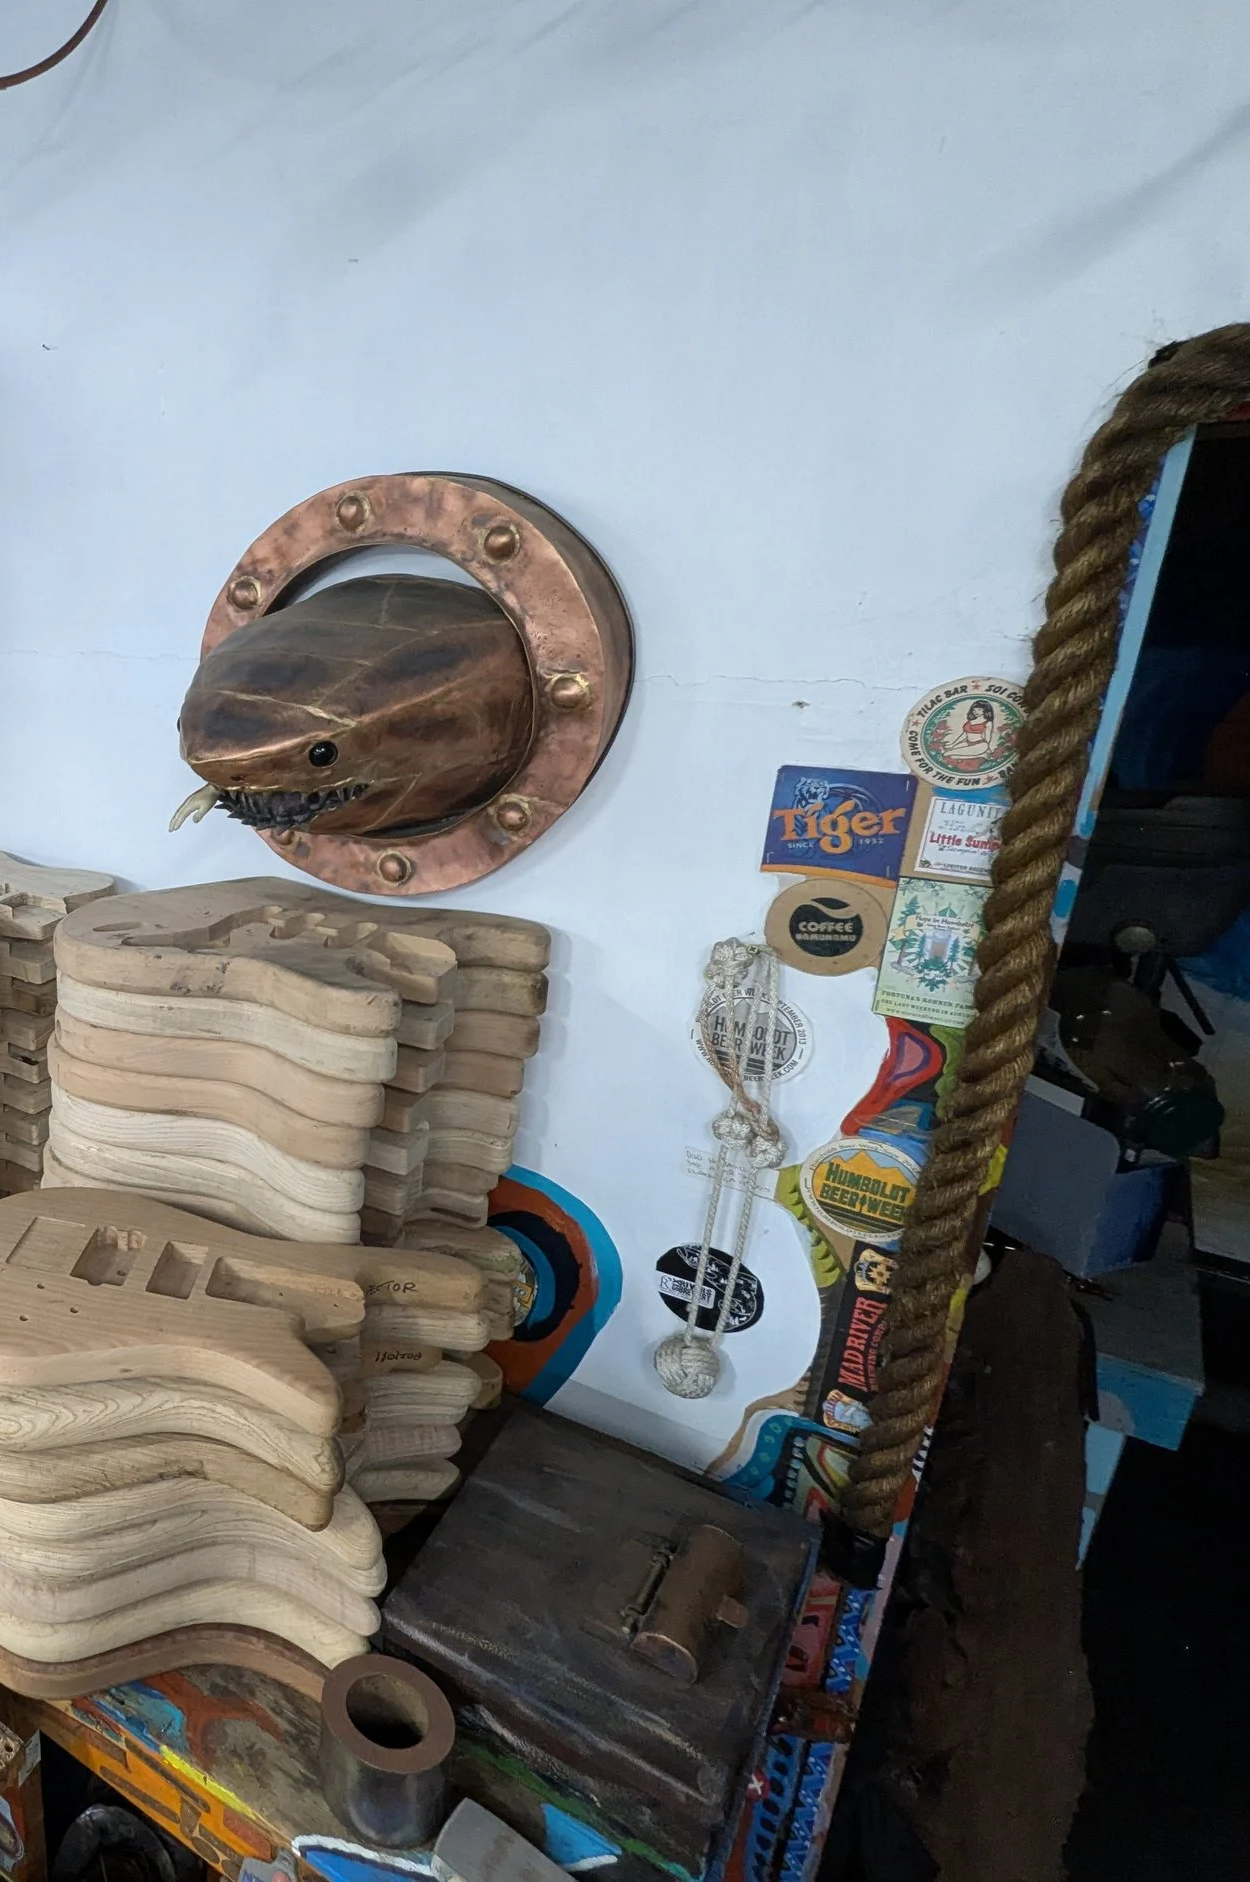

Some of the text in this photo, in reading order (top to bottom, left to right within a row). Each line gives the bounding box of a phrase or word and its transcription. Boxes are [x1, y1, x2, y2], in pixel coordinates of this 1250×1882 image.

[916, 685, 969, 718] TILAC BAR
[985, 684, 1008, 697] SOI
[908, 730, 981, 787] COME FOR THE FUN
[773, 800, 907, 855] Tiger
[787, 837, 885, 849] SINCE 1932
[798, 921, 855, 933] COFFEE
[797, 1028, 807, 1046] 2013
[820, 1182, 860, 1209] BEER
[825, 1161, 911, 1204] HUMBOLDT
[837, 1296, 889, 1393] MAD RIVER
